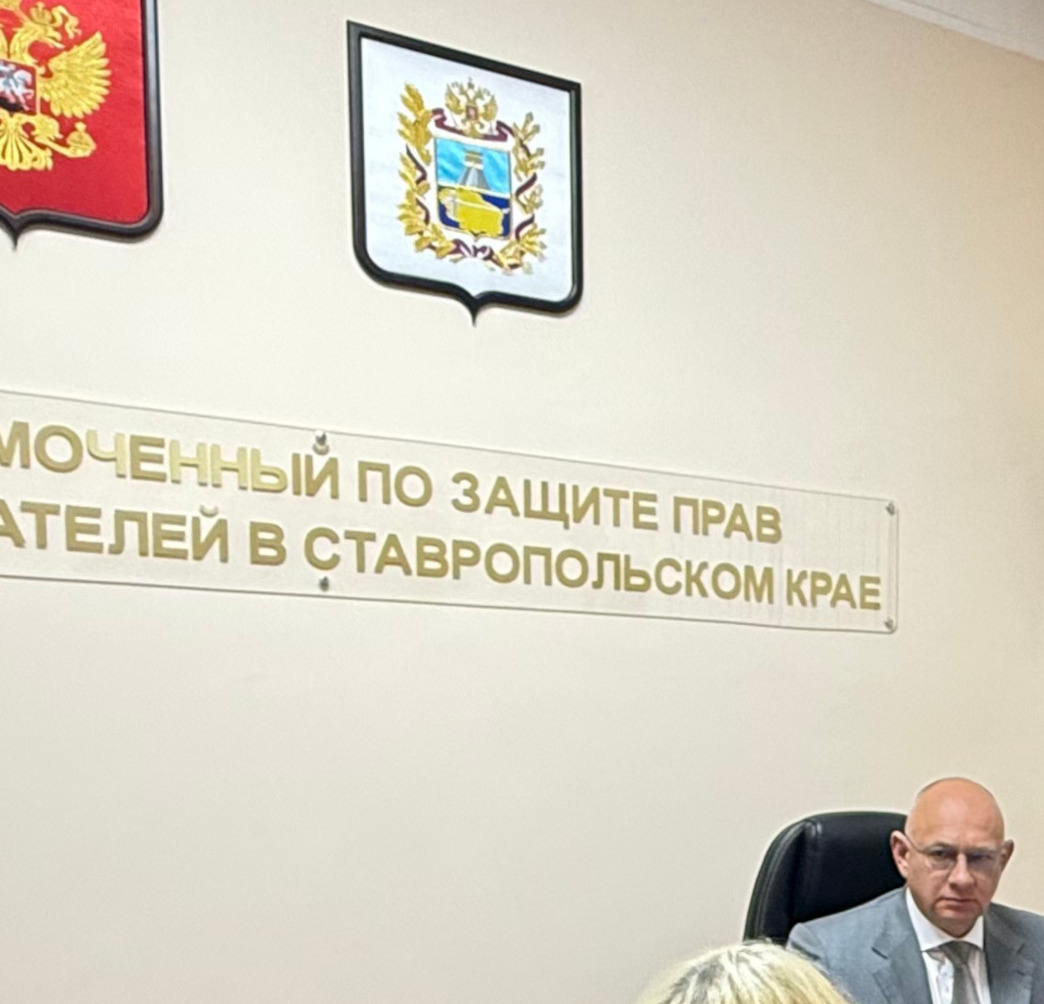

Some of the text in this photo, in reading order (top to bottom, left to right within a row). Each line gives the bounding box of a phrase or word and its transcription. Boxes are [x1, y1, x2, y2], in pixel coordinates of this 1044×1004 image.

[356, 459, 434, 507] ПО
[450, 471, 658, 530] ЗАЩИТЕ
[672, 495, 783, 545] ПРАВ
[249, 521, 287, 566] В
[303, 526, 775, 605] СТАВРОПОЛЬСКОМ
[785, 568, 882, 611] КРАЕ
